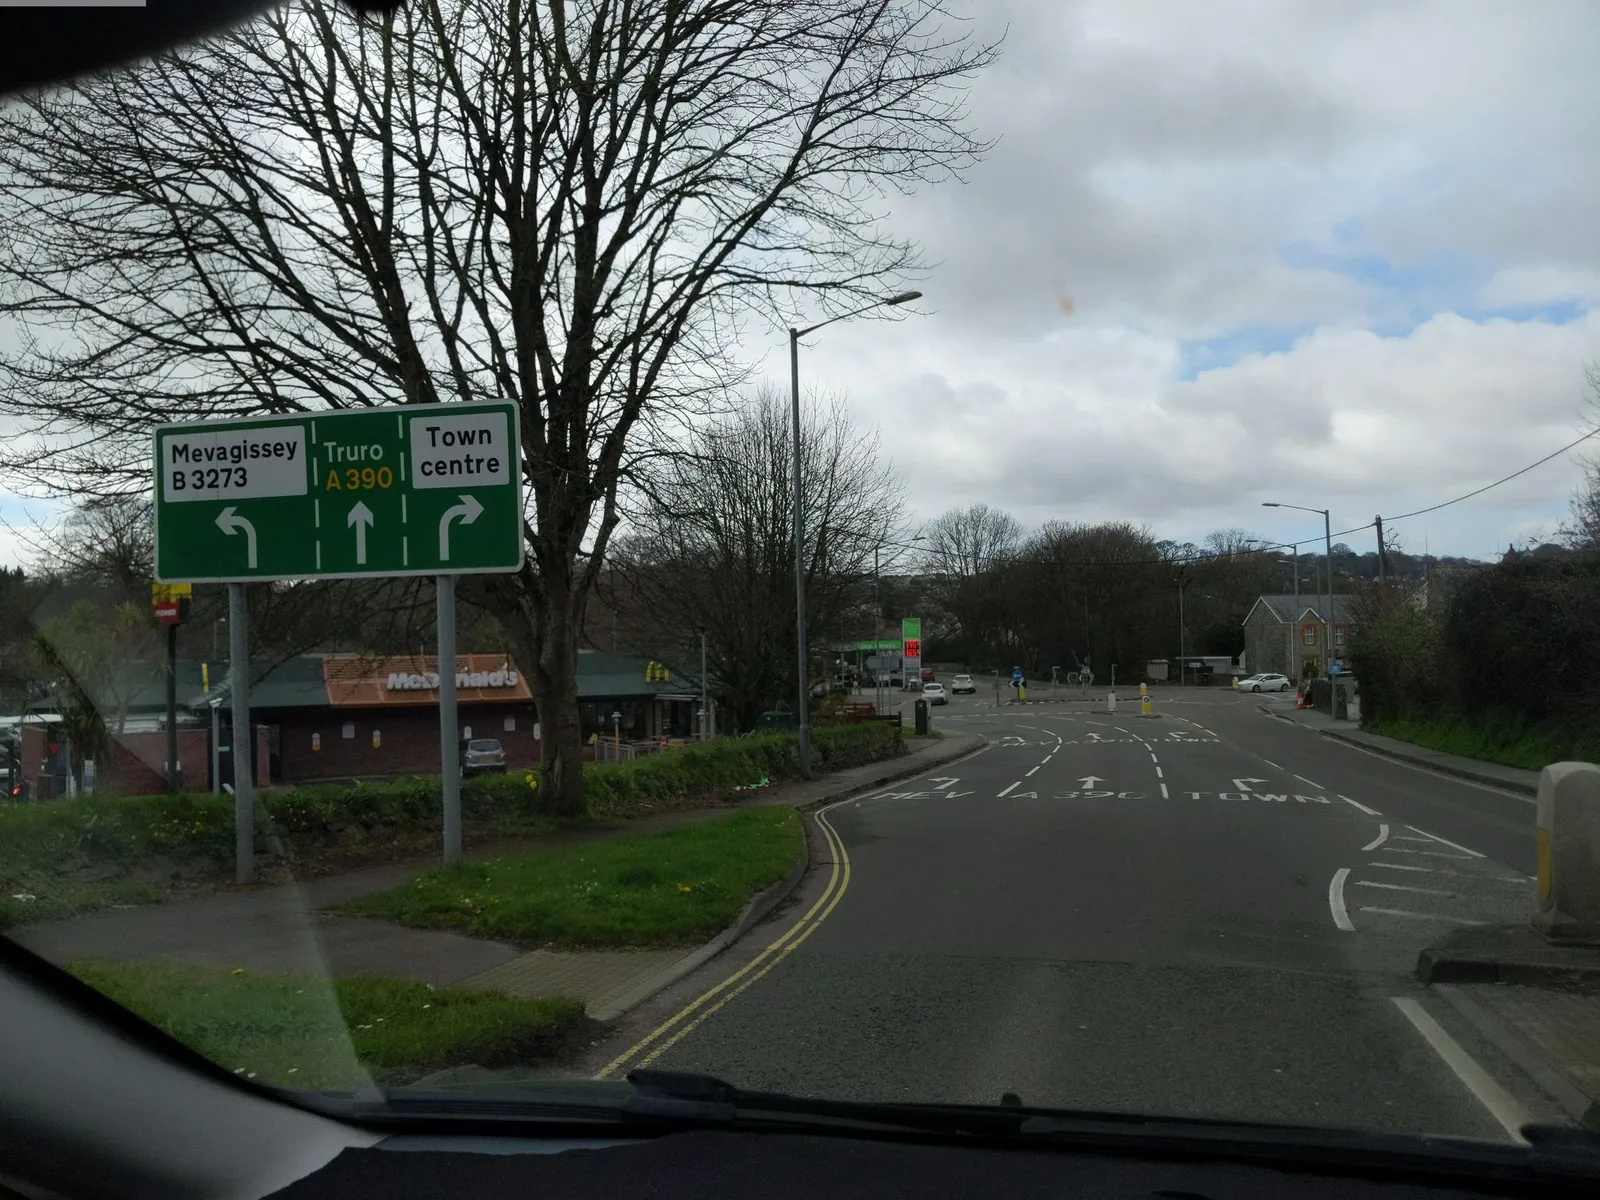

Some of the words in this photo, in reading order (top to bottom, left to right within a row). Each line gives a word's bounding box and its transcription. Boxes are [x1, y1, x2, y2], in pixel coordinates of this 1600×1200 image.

[426, 427, 492, 448] Town
[172, 440, 298, 468] Mevagissey
[324, 442, 384, 463] Truro
[420, 453, 500, 477] centre
[173, 471, 186, 491] B
[192, 468, 248, 490] 3273
[325, 470, 341, 491] A
[346, 467, 393, 490] 390
[387, 670, 519, 690] McDnald's
[1184, 791, 1331, 804] TOWN
